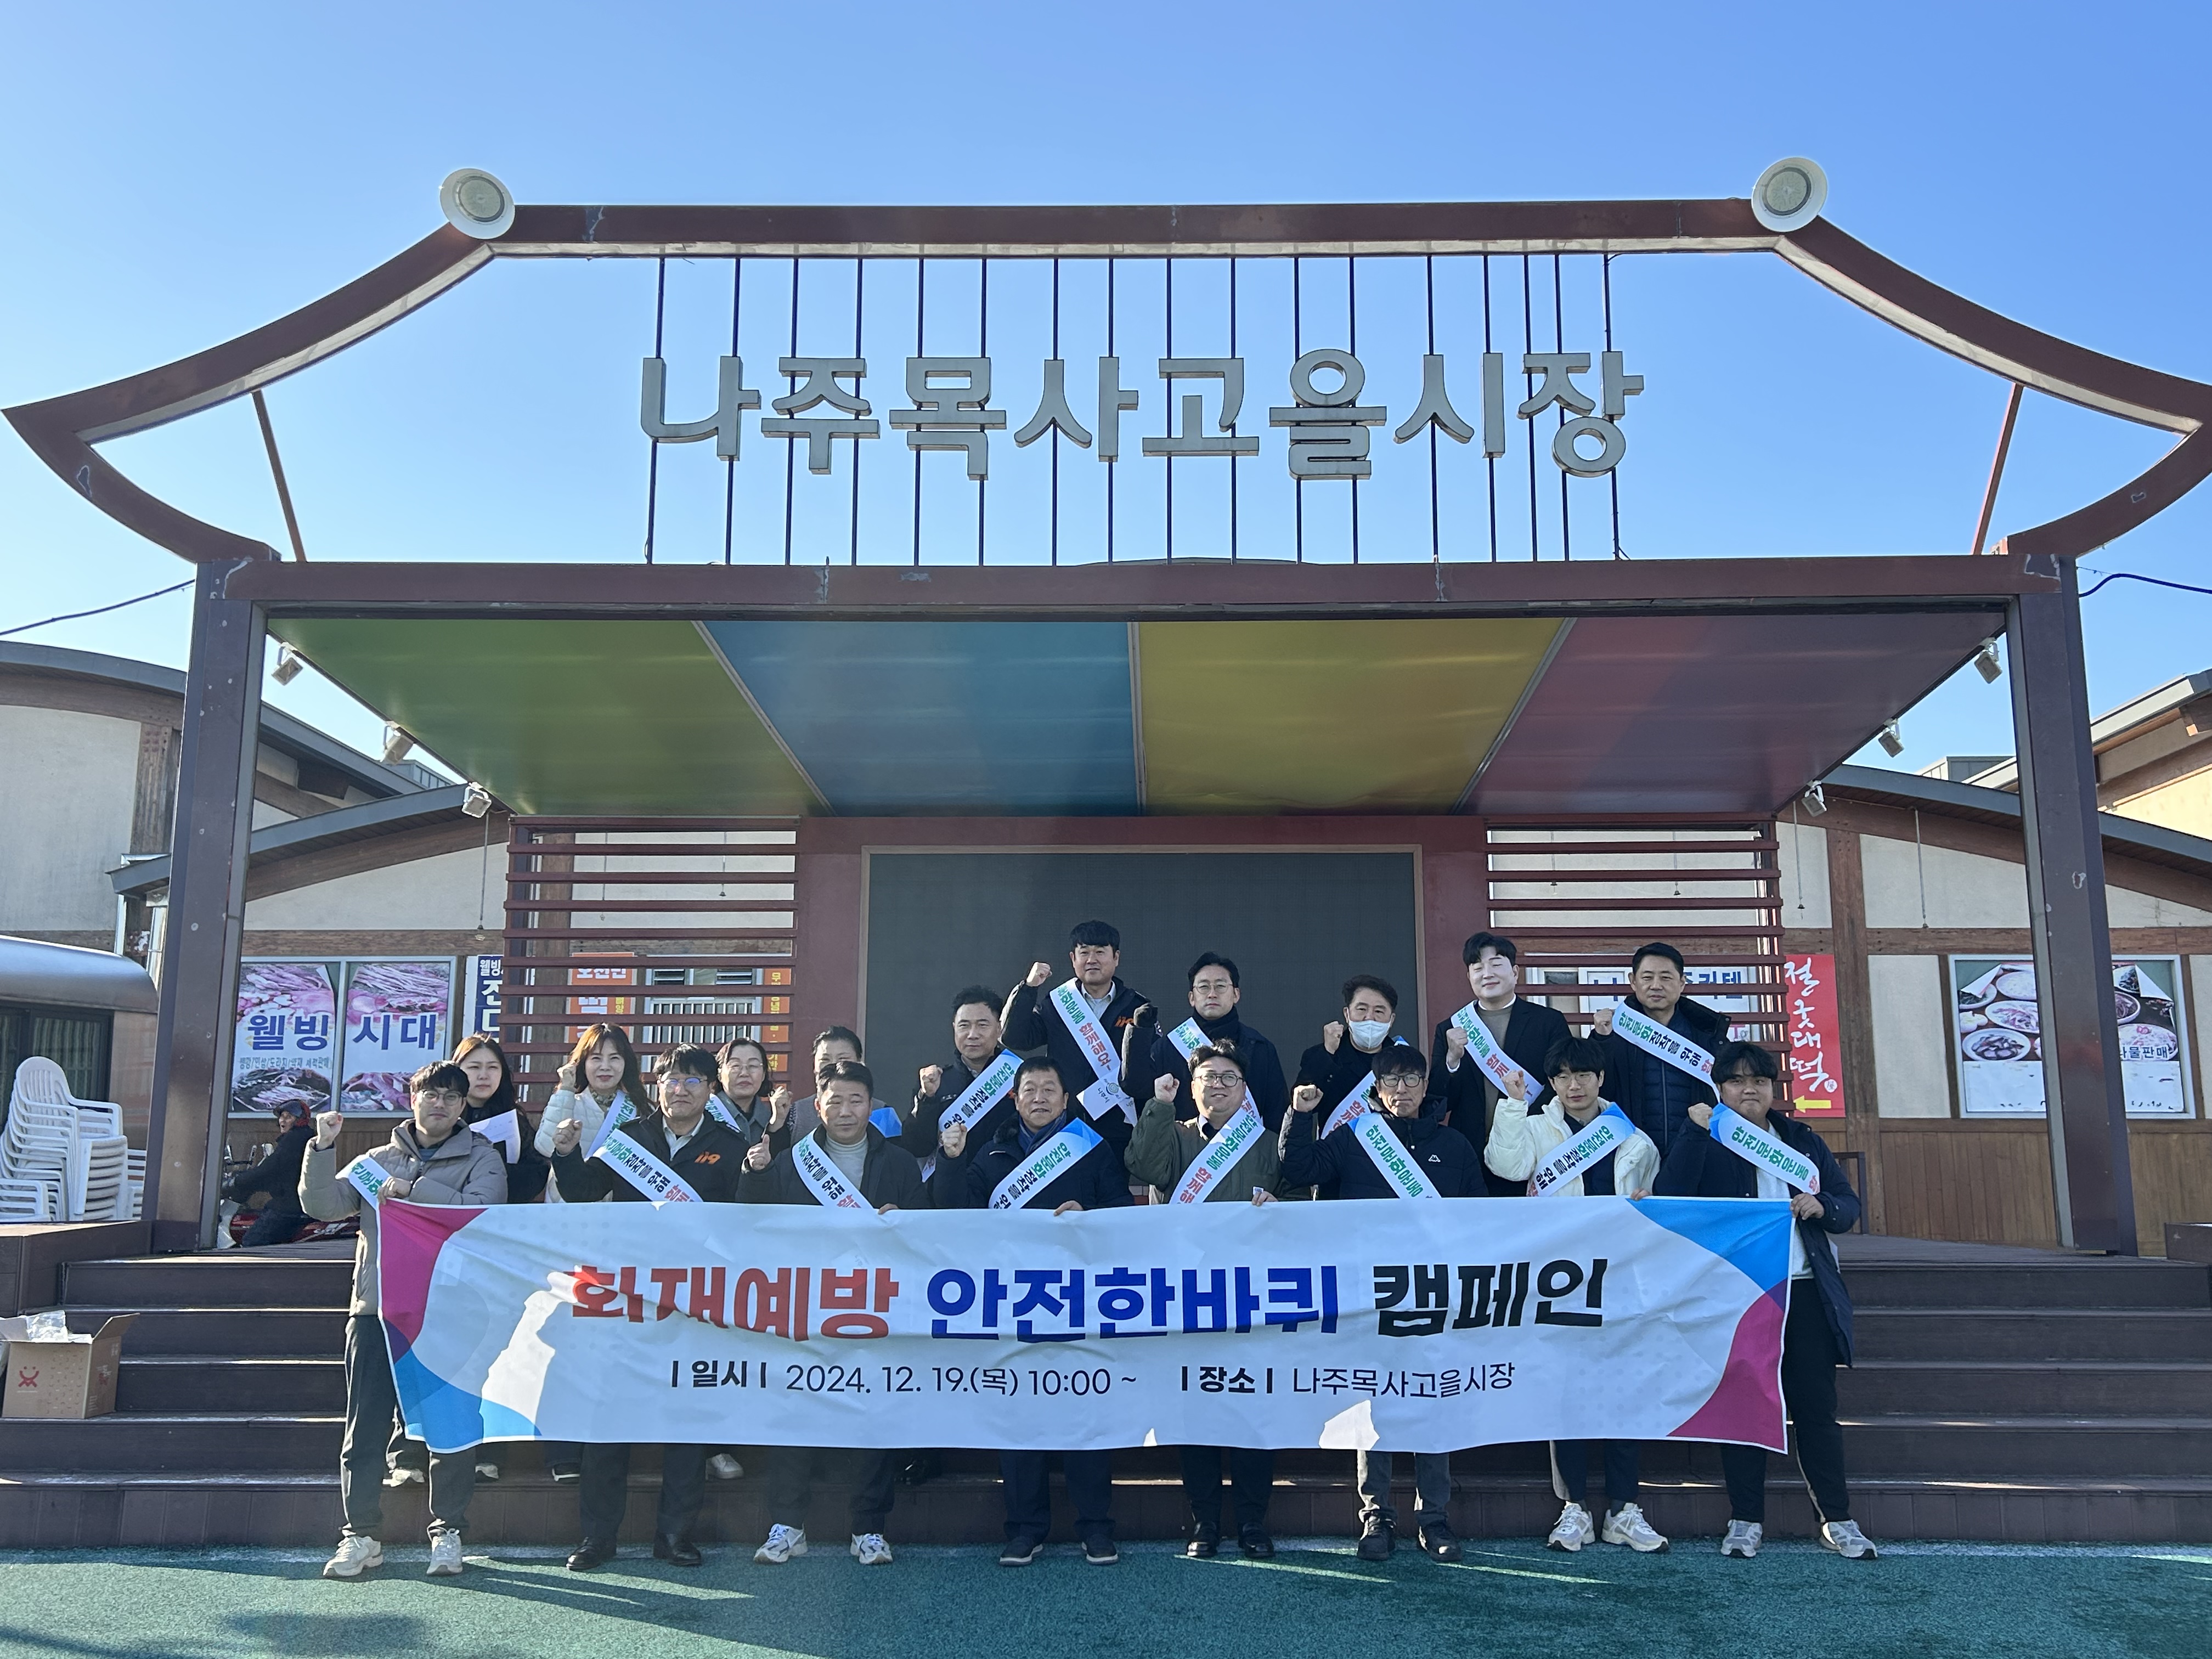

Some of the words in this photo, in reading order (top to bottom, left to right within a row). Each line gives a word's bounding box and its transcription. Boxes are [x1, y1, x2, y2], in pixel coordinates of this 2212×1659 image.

[641, 348, 1644, 480] 나주목사고을시장
[480, 959, 503, 977] 웰빙
[247, 1014, 329, 1051] 웰빙
[353, 1014, 438, 1051] 시대
[1079, 1022, 1112, 1071] 함께해요!
[1618, 1011, 1681, 1054] 안전문화정착을
[1680, 1047, 1702, 1067] 위해
[1784, 957, 1830, 1092] 절굿대떡
[961, 1062, 1015, 1118] 안전문화정착을
[694, 1150, 721, 1165] 119
[1206, 1114, 1259, 1171] 안전문화운동
[1365, 1124, 1424, 1198] 안전문화운동
[1553, 1125, 1615, 1176] 안전문화정착을
[1731, 1125, 1809, 1181] 안전문화운동
[647, 1170, 672, 1193] 위해
[821, 1176, 845, 1200] 위해
[1007, 1142, 1072, 1200] 안전문화정착을
[1180, 1166, 1213, 1204] 함께해
[1536, 1167, 1558, 1190] 위해
[563, 1265, 900, 1342] 화재예방
[927, 1266, 1339, 1342] 안전한바퀴
[1373, 1258, 1609, 1337] 캠페인
[691, 1359, 747, 1389] 일시
[785, 1364, 871, 1394] 2024.
[882, 1366, 922, 1393] 12.
[1028, 1368, 1111, 1396] 10:00
[1199, 1365, 1256, 1394] 장소
[1293, 1362, 1516, 1398] 나주목사고을시장
